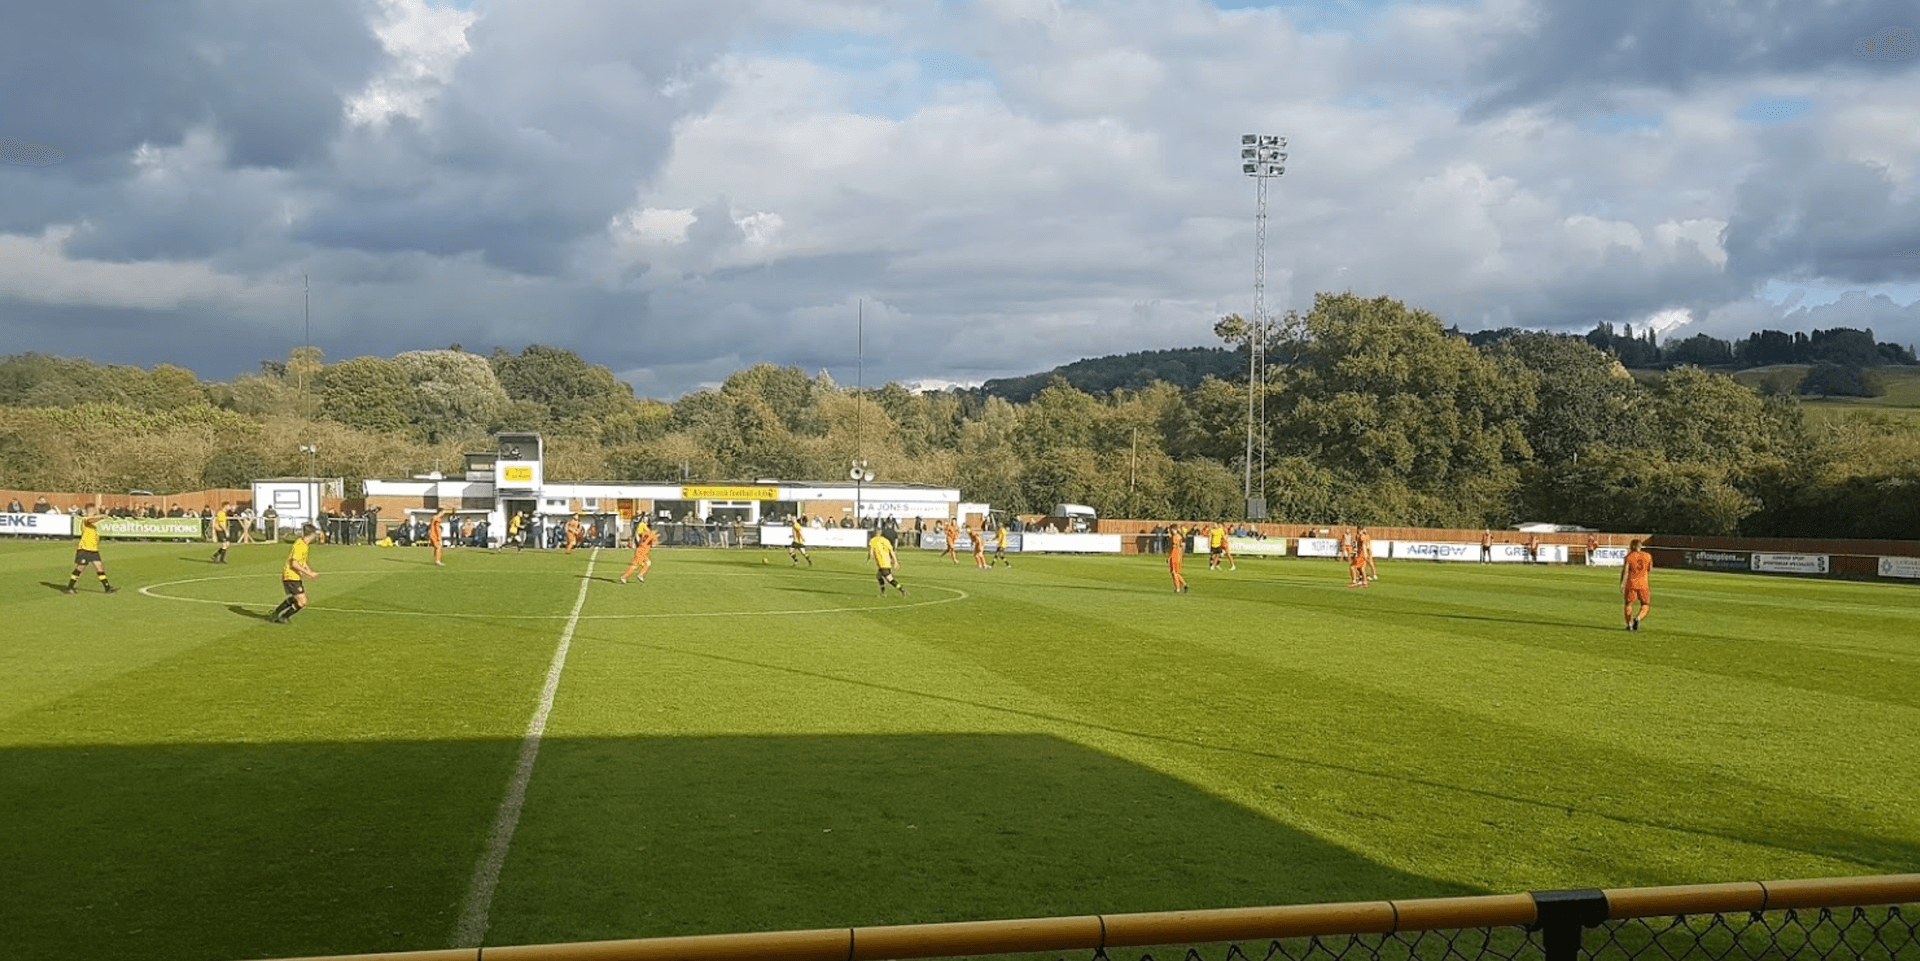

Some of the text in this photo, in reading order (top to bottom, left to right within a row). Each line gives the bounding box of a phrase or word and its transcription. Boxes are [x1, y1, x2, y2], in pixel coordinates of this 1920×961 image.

[876, 503, 911, 512] JONES
[1406, 544, 1467, 557] ARROW
[1595, 549, 1627, 559] RENKE
